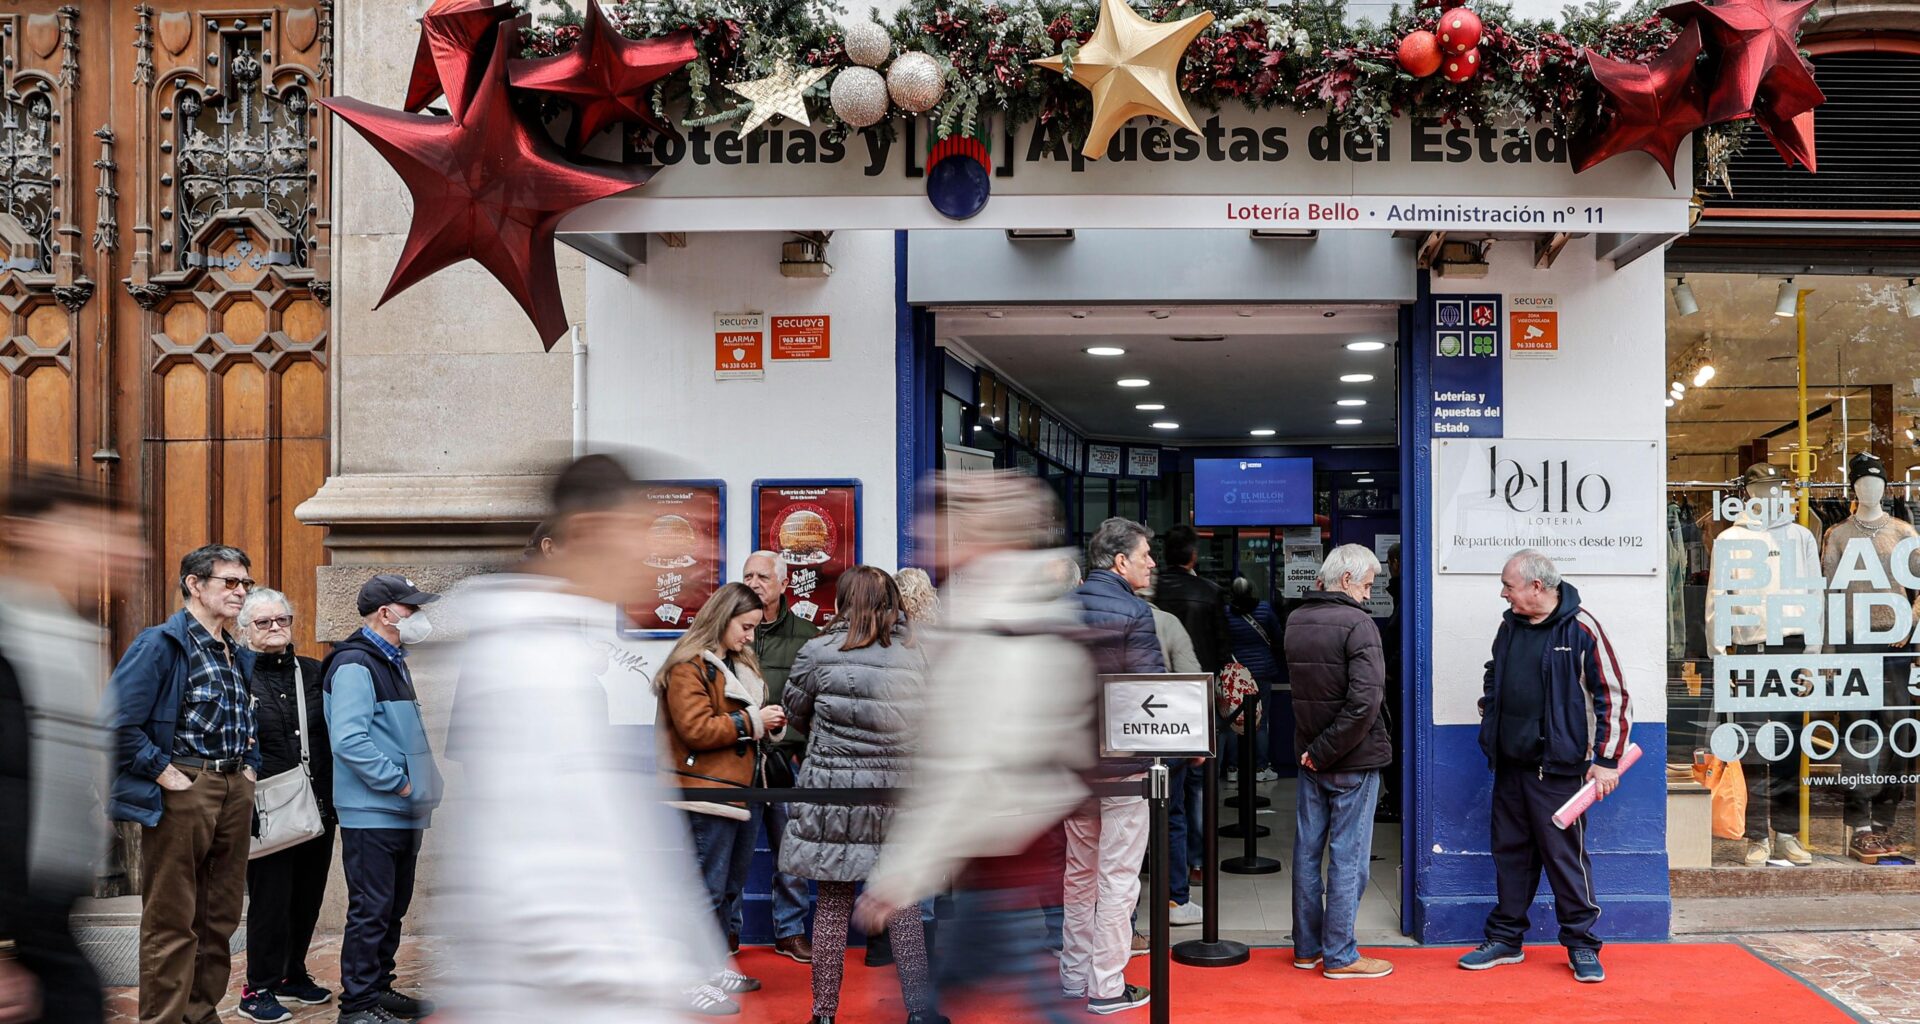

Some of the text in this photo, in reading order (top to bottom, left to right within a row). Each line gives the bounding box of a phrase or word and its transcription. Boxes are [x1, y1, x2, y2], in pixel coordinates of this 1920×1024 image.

[857, 128, 892, 176] y
[1308, 112, 1391, 162] del
[1411, 116, 1567, 163] Estad
[1227, 202, 1603, 223] Lotería Bello Administración nº 11
[777, 319, 824, 328] secuoya
[1435, 391, 1485, 404] Loterías y
[1435, 407, 1500, 419] Apuestas del
[1435, 422, 1469, 432] Estado
[1488, 445, 1611, 513] bello
[1712, 486, 1796, 531] legit
[1453, 534, 1643, 549] Repartiendo millones desde 1912
[1713, 592, 1920, 646] FRID
[1729, 668, 1869, 698] HASTA
[1123, 723, 1190, 735] ENTRADA
